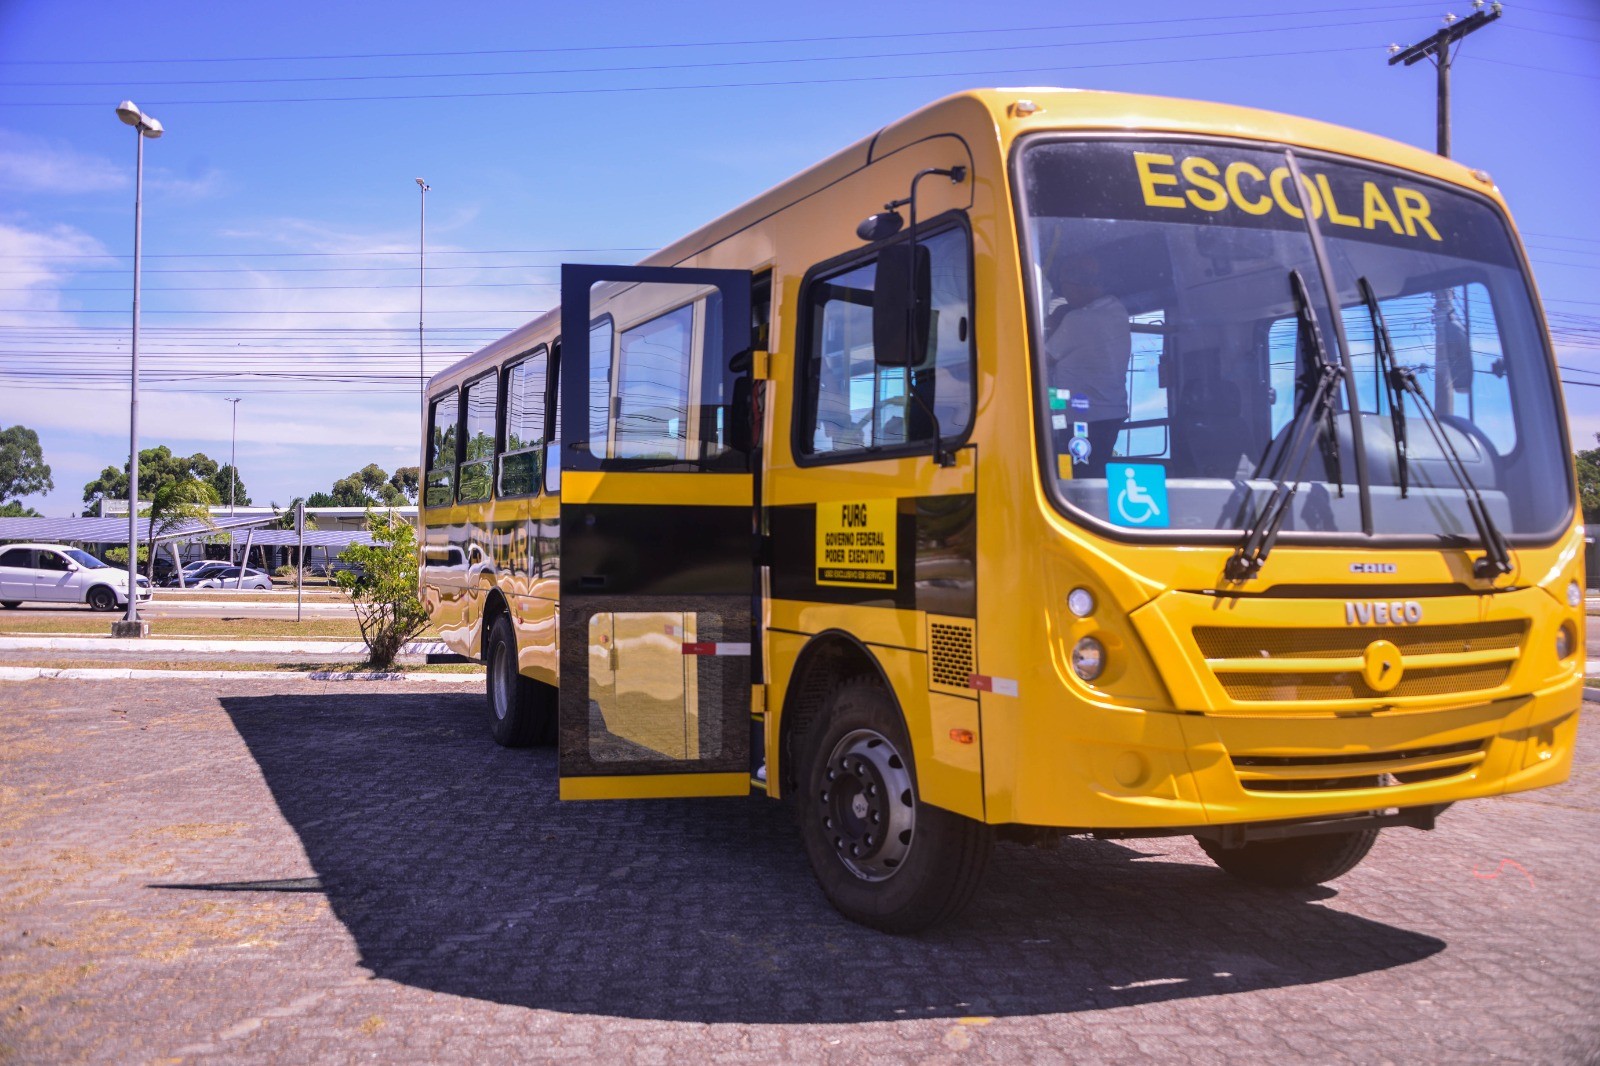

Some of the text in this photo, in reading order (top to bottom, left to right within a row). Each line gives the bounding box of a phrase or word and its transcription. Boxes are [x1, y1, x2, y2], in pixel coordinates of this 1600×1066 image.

[1133, 151, 1443, 241] ESCOLAR
[842, 504, 867, 527] FURG
[825, 532, 885, 546] GOVERNO FEDERAL
[825, 549, 885, 564] PODER EXECUTIVO
[1345, 601, 1422, 625] IVECO
